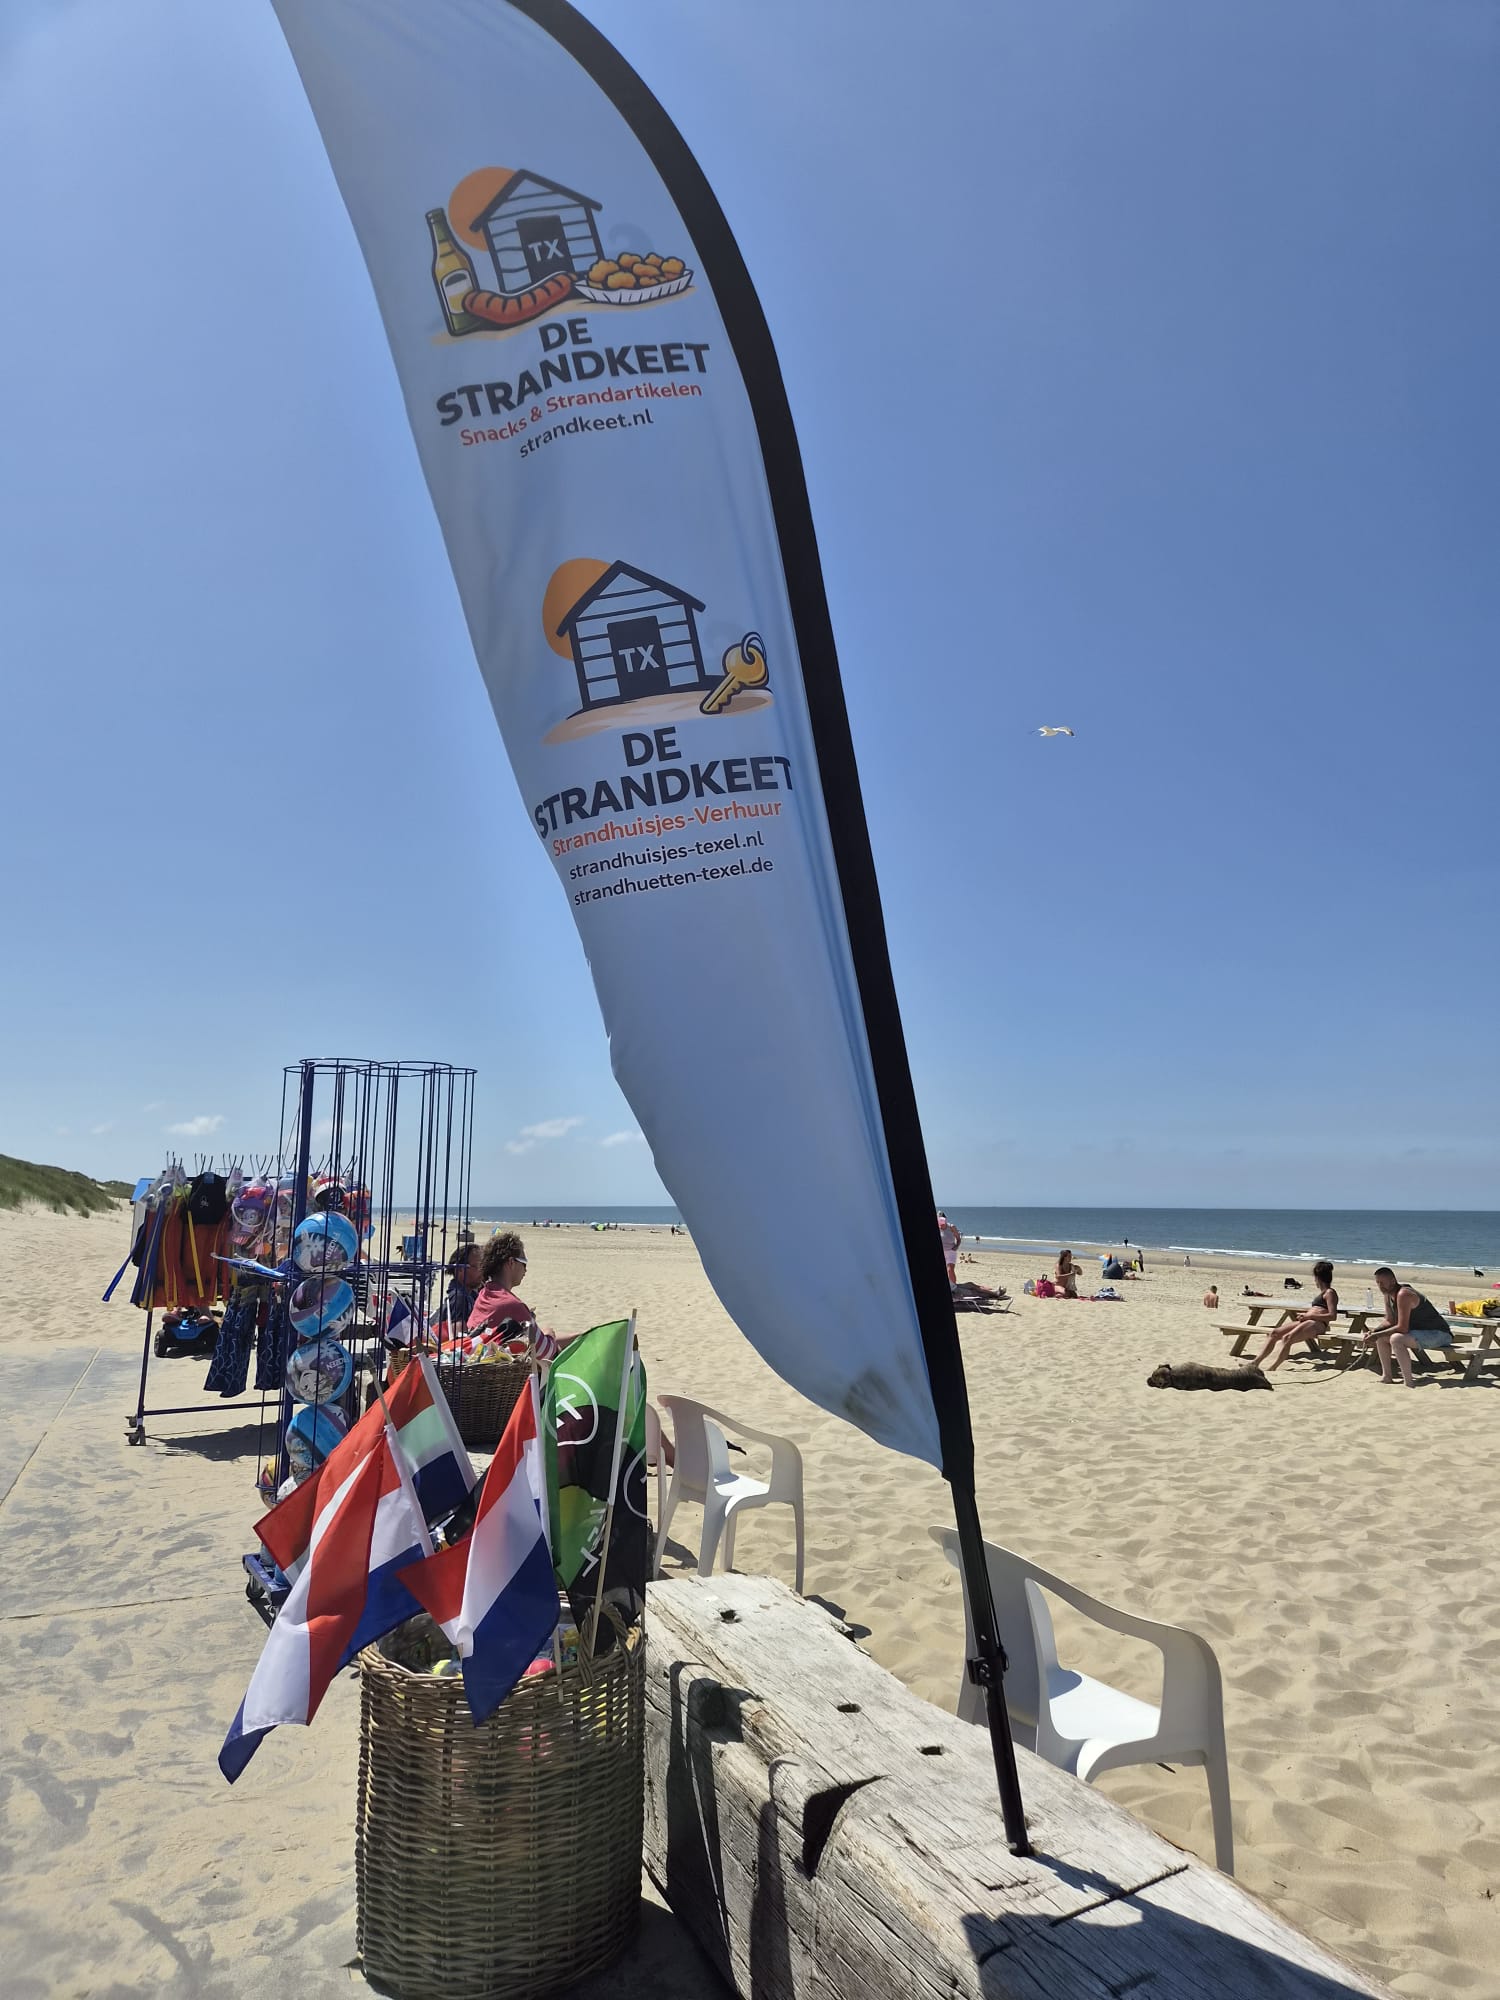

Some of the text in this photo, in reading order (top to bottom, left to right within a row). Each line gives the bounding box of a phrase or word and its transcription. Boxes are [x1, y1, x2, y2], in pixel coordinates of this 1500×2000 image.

[528, 238, 565, 263] TX
[538, 317, 593, 353] DE
[435, 342, 711, 427] STRANDKEET
[460, 382, 703, 447] Snacks & Strandartikelen
[518, 408, 655, 459] strandkeet.nl
[618, 644, 660, 674] TX
[621, 726, 683, 768] DE
[533, 755, 794, 840] STRANDKEET
[552, 799, 783, 857] Strandhuisjes-Verhuur
[569, 831, 765, 881] strandhuisjes-texel.nl
[573, 856, 775, 906] strandhuetten-texel.de
